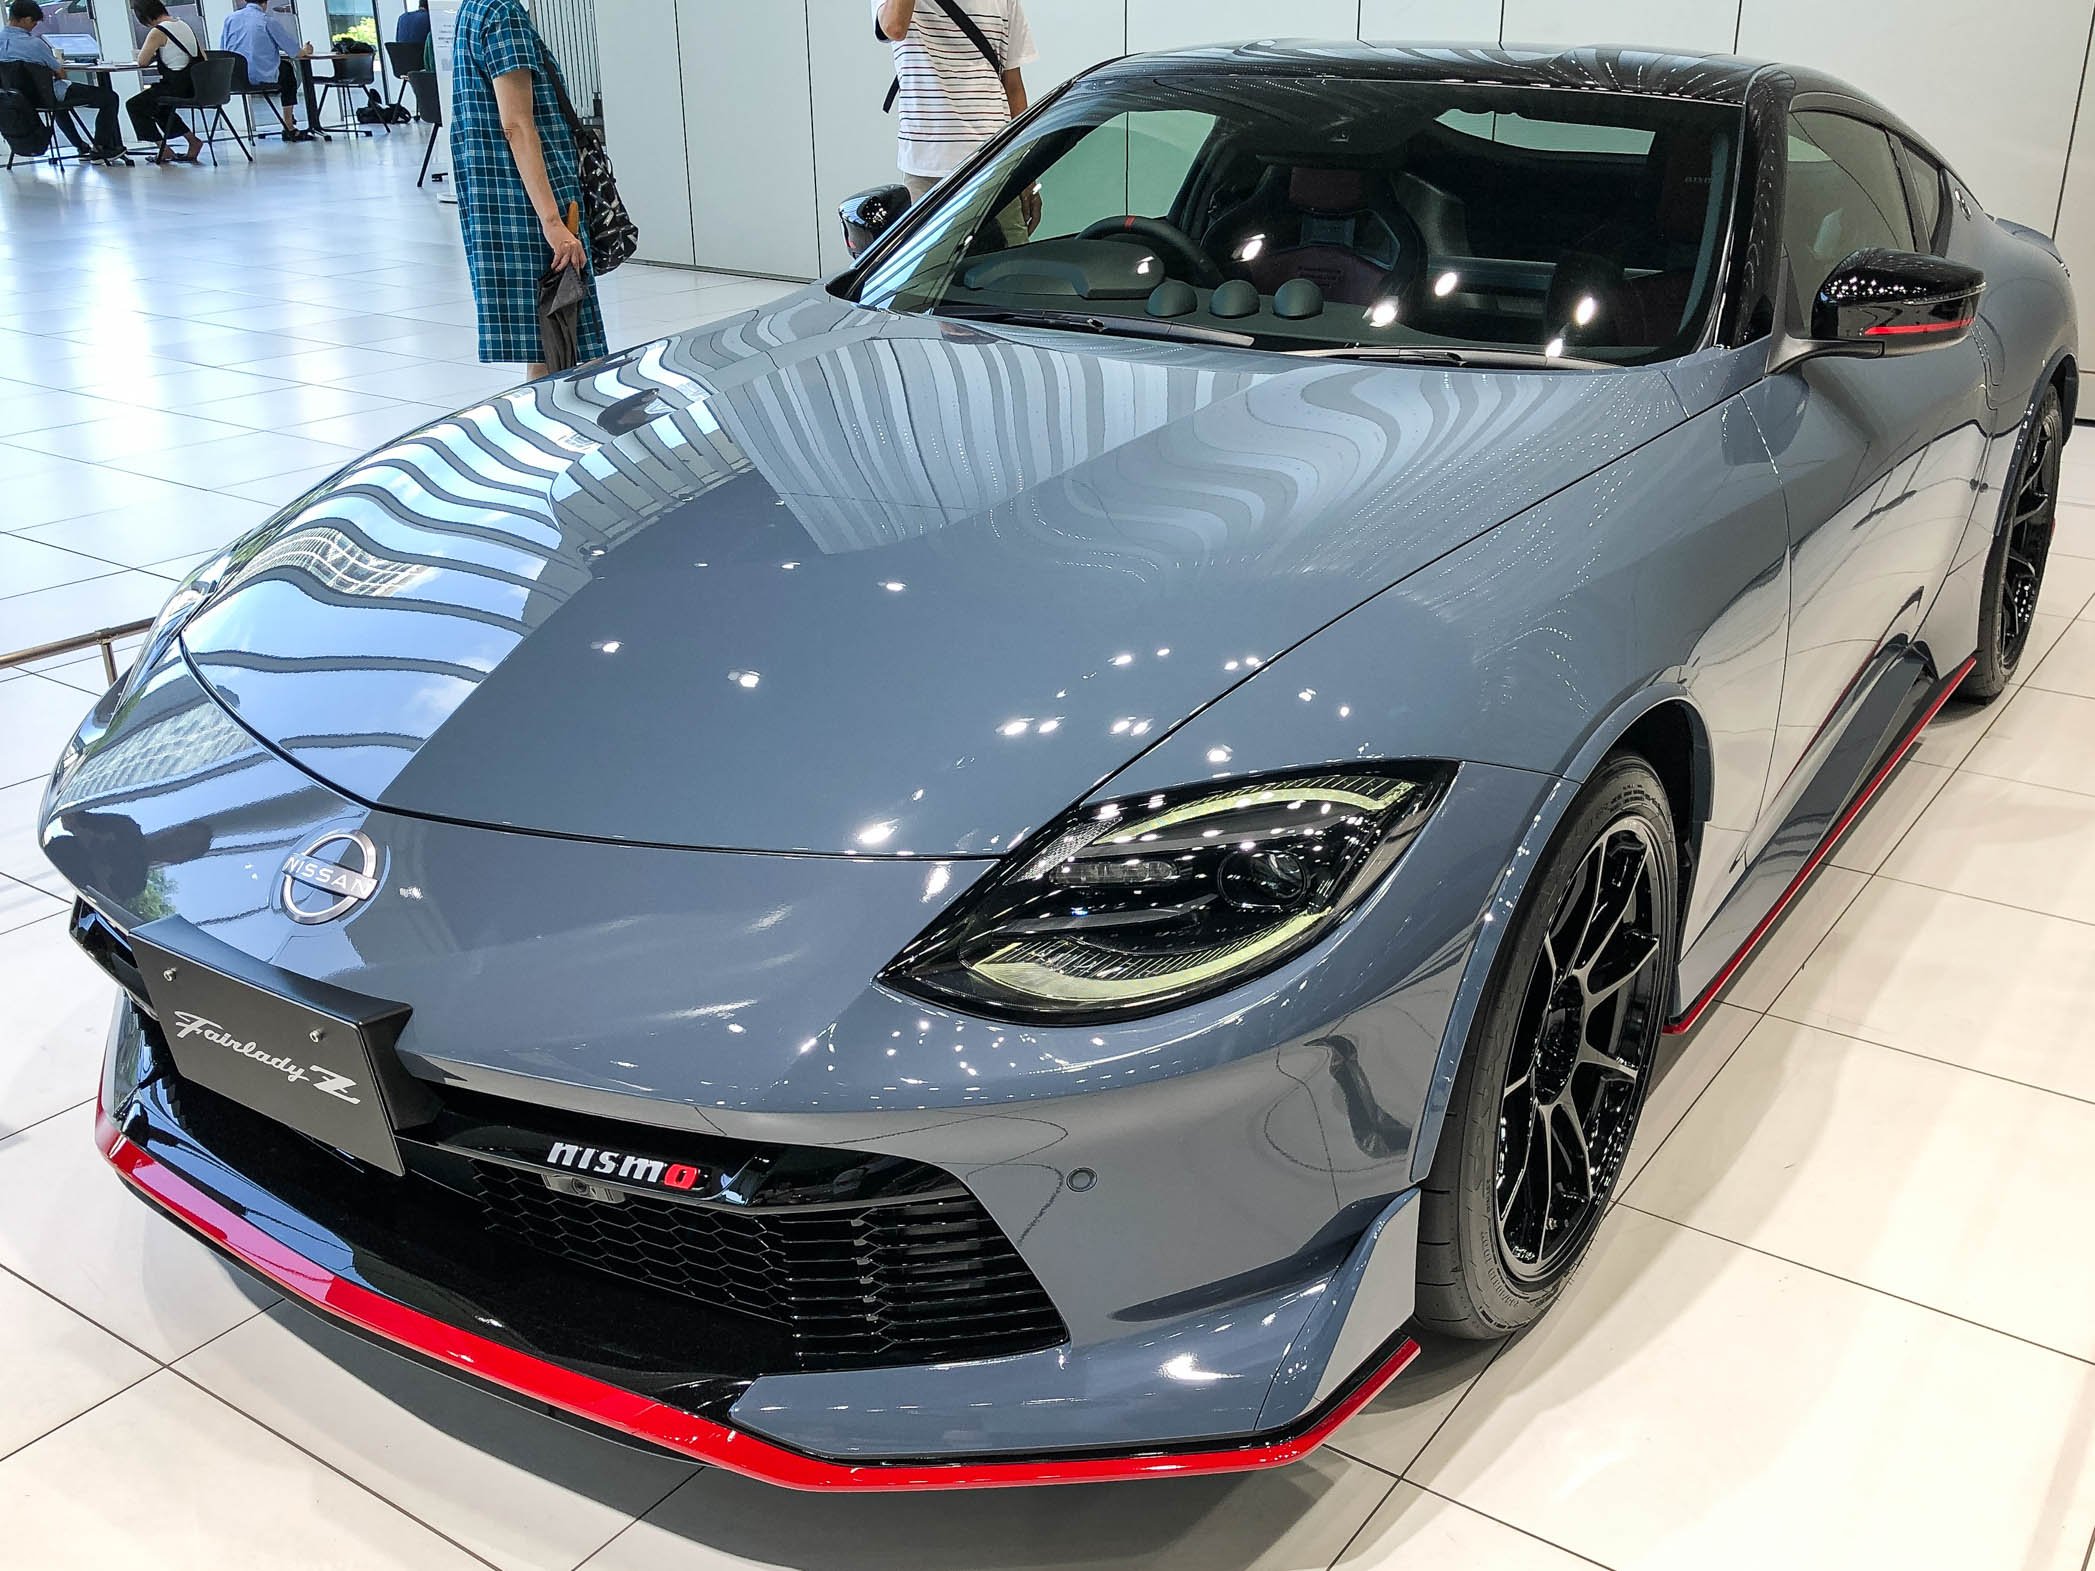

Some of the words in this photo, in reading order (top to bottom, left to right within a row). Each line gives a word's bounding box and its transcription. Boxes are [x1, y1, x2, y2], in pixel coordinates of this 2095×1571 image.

[281, 856, 374, 897] NISSAN
[174, 1010, 310, 1082] Fairlady
[309, 1064, 361, 1105] Z
[546, 1141, 698, 1190] nismo
